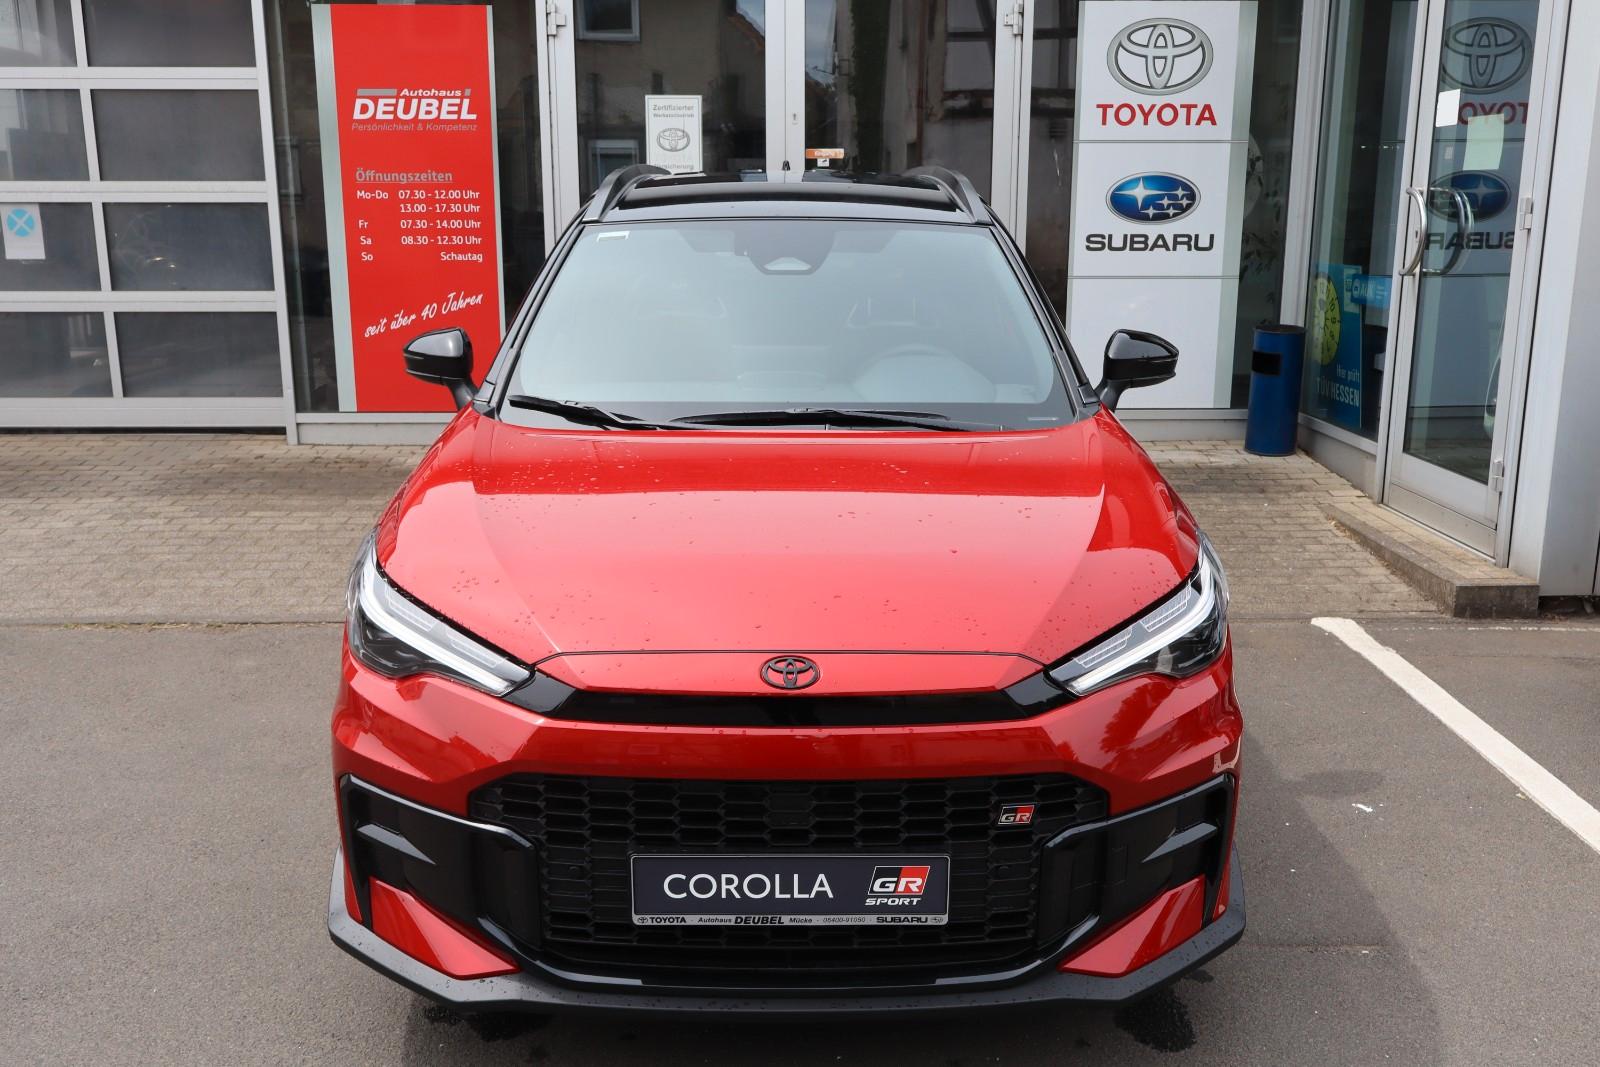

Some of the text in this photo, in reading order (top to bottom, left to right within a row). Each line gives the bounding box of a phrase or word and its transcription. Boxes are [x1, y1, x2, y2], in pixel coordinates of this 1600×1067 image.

[400, 88, 462, 97] Autohaus
[352, 98, 477, 120] DEUBEL
[1096, 103, 1217, 126] TOYOTA
[352, 122, 477, 133] Persönlichkeit & Kompetenz
[355, 168, 453, 184] Öffnungszeiten
[356, 190, 389, 199] Mo-Do
[398, 190, 426, 199] 07.30
[434, 190, 461, 199] 12.00
[462, 190, 480, 199] Uhr
[400, 203, 426, 213] 13.00
[435, 203, 462, 213] 17.30
[463, 203, 481, 213] Uhr
[358, 220, 368, 229] Fr
[400, 219, 427, 229] 07.30
[436, 219, 462, 229] 14.00
[464, 219, 481, 229] Uhr
[360, 235, 372, 245] Sa
[401, 235, 428, 245] 08.30
[437, 235, 463, 245] 12.30
[465, 235, 482, 245] Uhr
[1085, 233, 1215, 252] SUBARU
[361, 252, 483, 262] So Schautag
[364, 291, 483, 338] seit über 40 Jahren
[1316, 376, 1359, 407] TÜV HESSEN
[1000, 812, 1030, 823] GR
[663, 873, 834, 899] COROLLA
[872, 876, 923, 893] GR
[864, 898, 921, 906] SPORT
[649, 916, 686, 924] TOYOTA
[734, 916, 784, 925] DEUBEL
